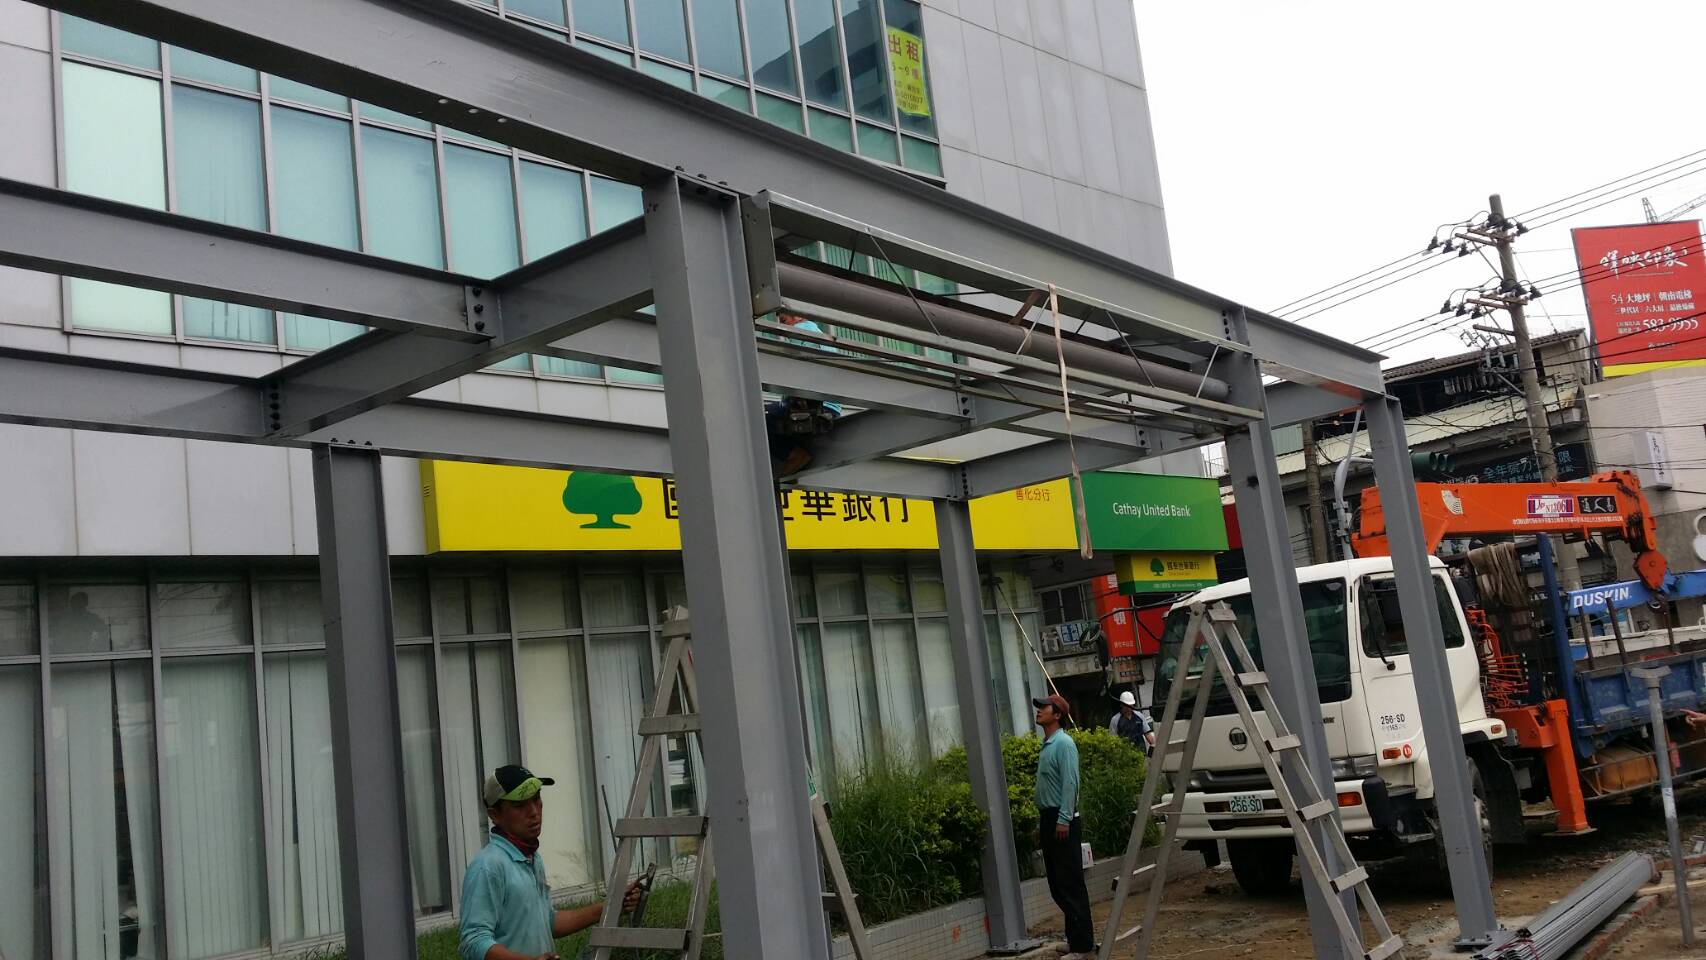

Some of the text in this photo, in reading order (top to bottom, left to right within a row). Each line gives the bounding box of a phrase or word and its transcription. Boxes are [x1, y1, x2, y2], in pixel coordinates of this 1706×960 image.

[888, 34, 920, 63] 出租
[1112, 502, 1191, 518] Cathay United Bank
[1573, 587, 1629, 609] DUSKIN
[1380, 713, 1405, 725] 256-SD
[1231, 799, 1262, 812] 256-SD
